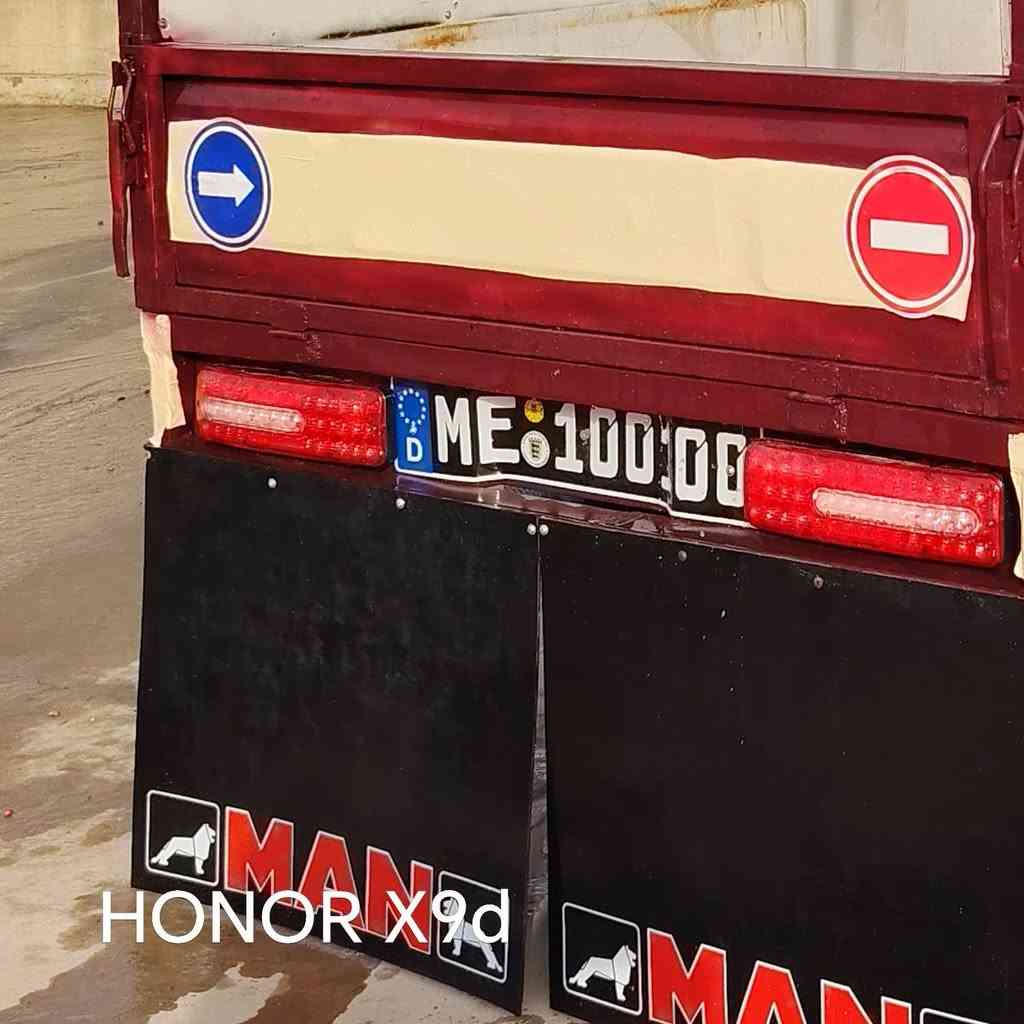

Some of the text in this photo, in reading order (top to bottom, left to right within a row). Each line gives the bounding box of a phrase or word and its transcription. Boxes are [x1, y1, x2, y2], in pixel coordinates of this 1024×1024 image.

[406, 437, 423, 463] D
[434, 394, 521, 466] ME
[223, 805, 434, 955] MAN
